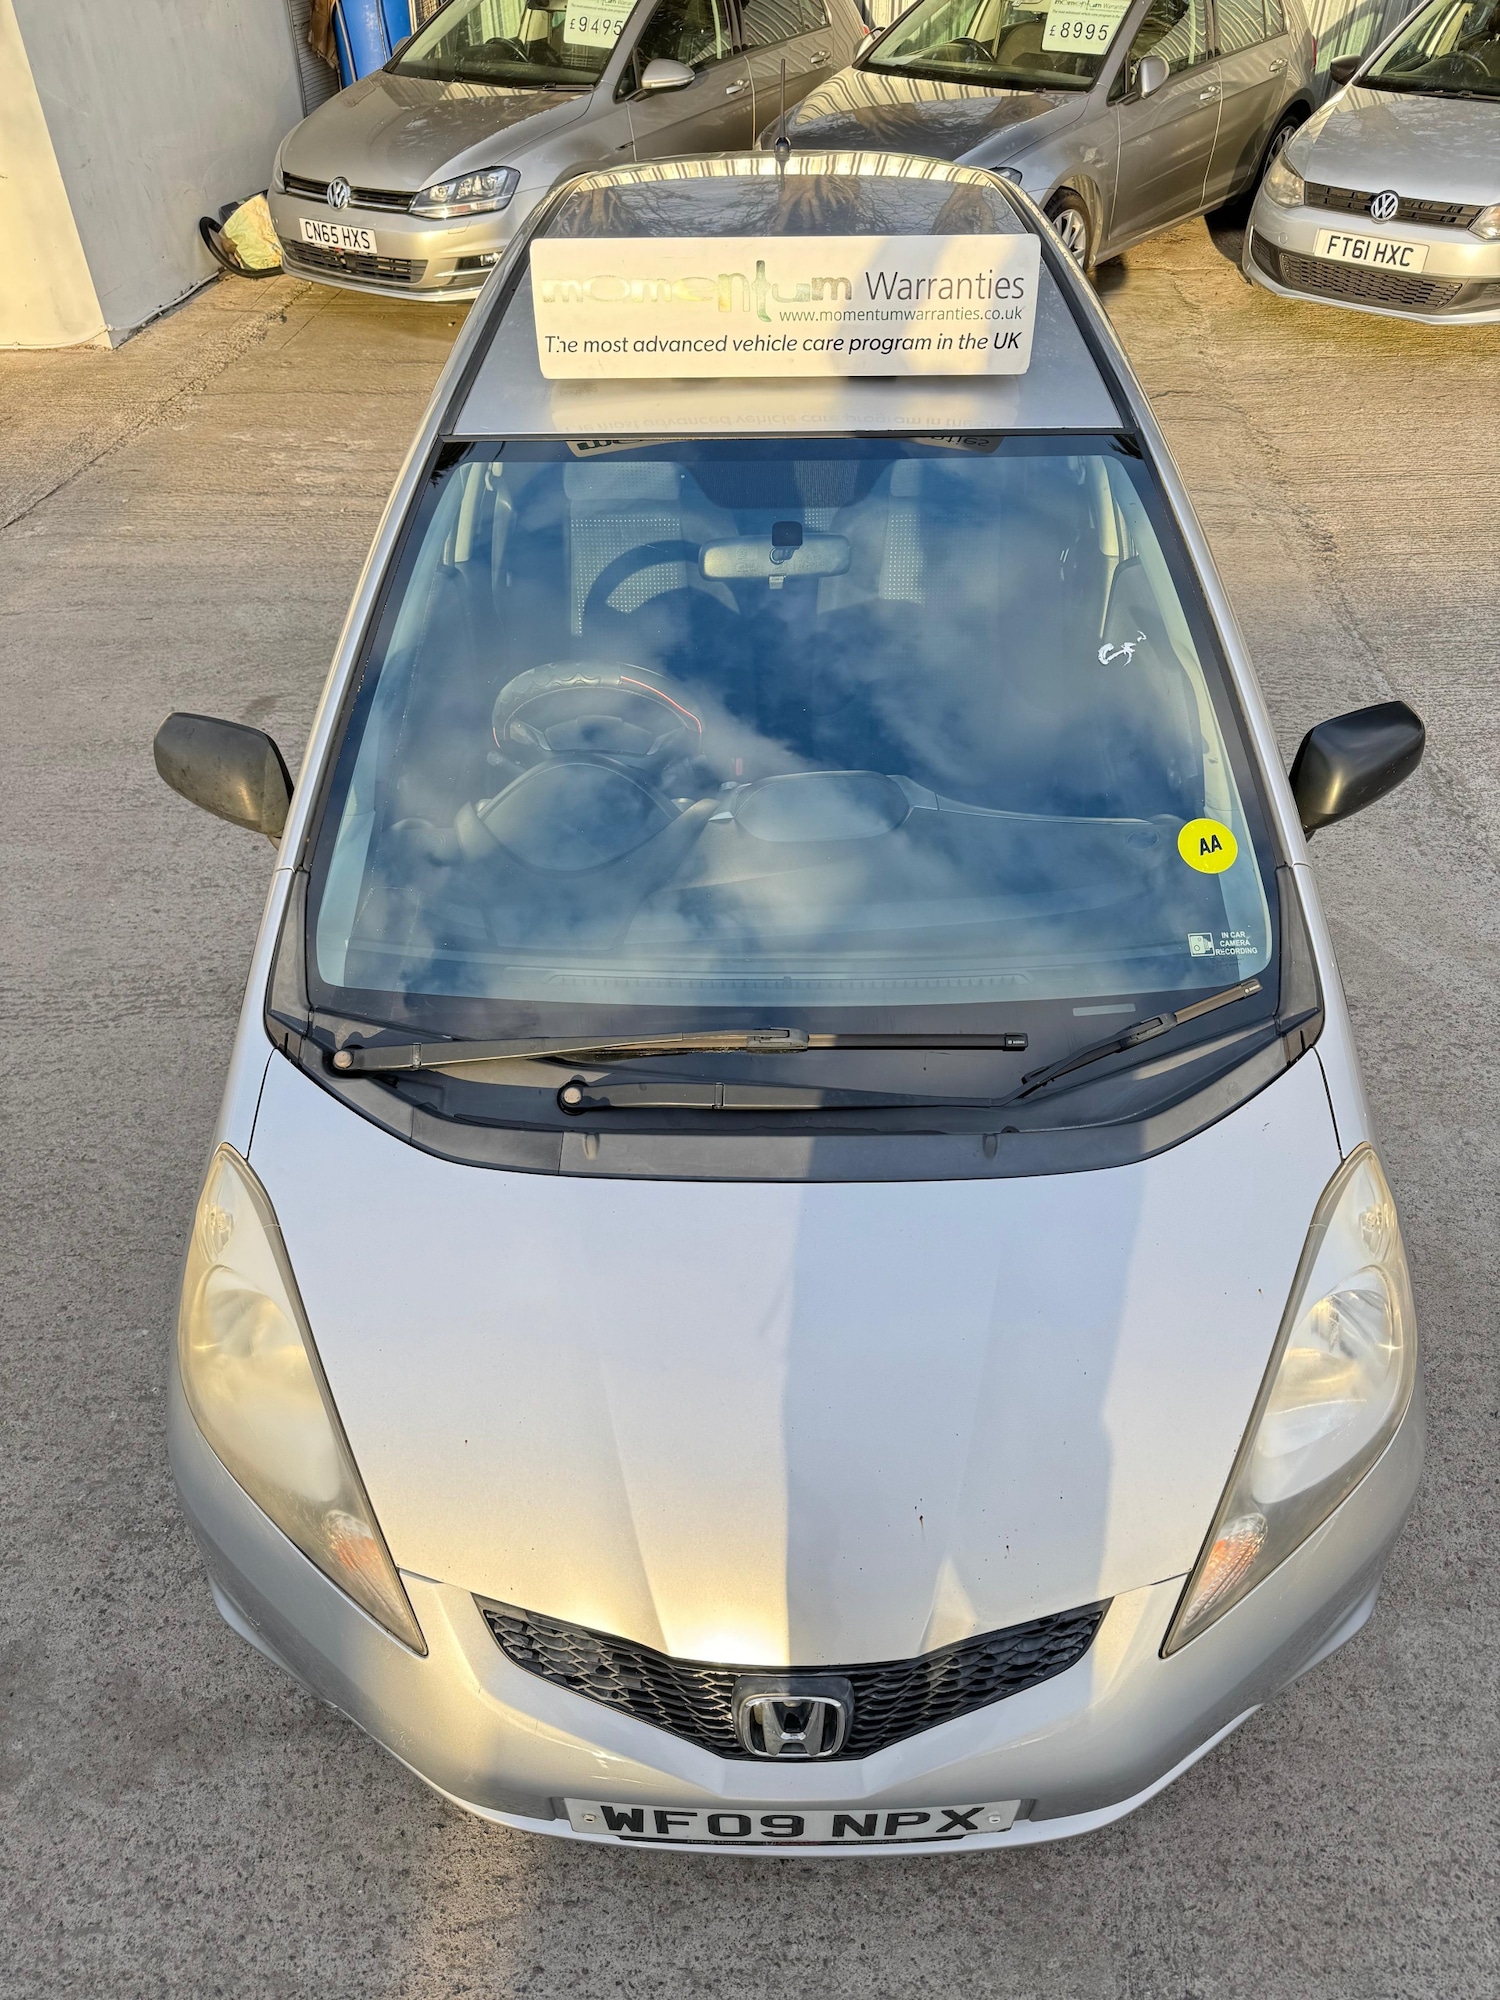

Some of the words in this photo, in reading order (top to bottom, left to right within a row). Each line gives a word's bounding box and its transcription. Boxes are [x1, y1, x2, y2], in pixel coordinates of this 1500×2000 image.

[569, 16, 624, 36] £9495
[1049, 22, 1109, 41] £8995
[304, 221, 339, 244] CN65
[342, 227, 371, 250] HXS
[1327, 235, 1371, 260] FT61
[1373, 242, 1414, 267] HXC
[865, 269, 1024, 301] Warranties
[779, 306, 1023, 322] www.momentumwarranties.co.uk
[583, 338, 628, 353] most
[633, 335, 728, 353] advanced
[732, 334, 798, 352] vehicle
[802, 336, 844, 352] care
[848, 336, 932, 355] program
[936, 333, 954, 350] in
[958, 333, 988, 350] the
[993, 331, 1022, 350] UK
[1200, 834, 1222, 856] AA
[1219, 939, 1251, 948] CAMERA
[1221, 931, 1229, 939] IN
[1230, 930, 1246, 939] CAR
[1215, 947, 1258, 956] RECORDING
[600, 1805, 805, 1838] WF09
[832, 1807, 985, 1838] NPX
